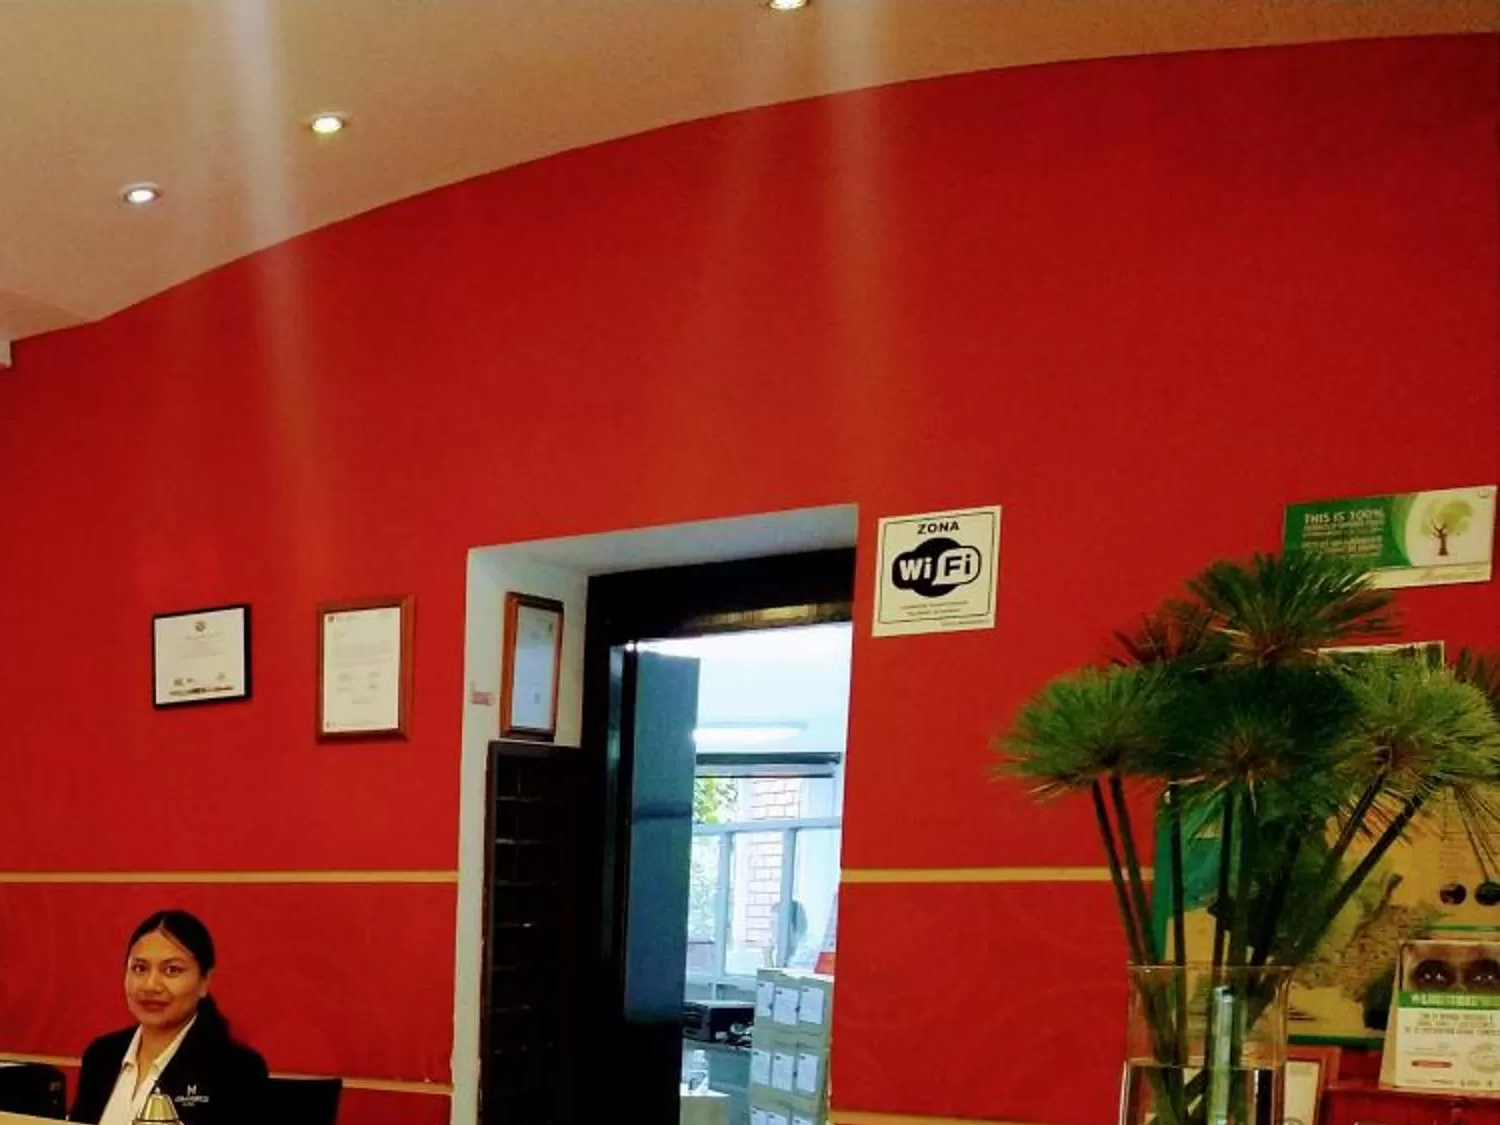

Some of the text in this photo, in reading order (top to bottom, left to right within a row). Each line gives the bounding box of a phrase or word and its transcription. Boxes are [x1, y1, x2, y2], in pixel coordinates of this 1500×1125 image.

[1305, 511, 1331, 525] THIS
[1334, 511, 1346, 523] IS
[917, 521, 960, 535] ZONA
